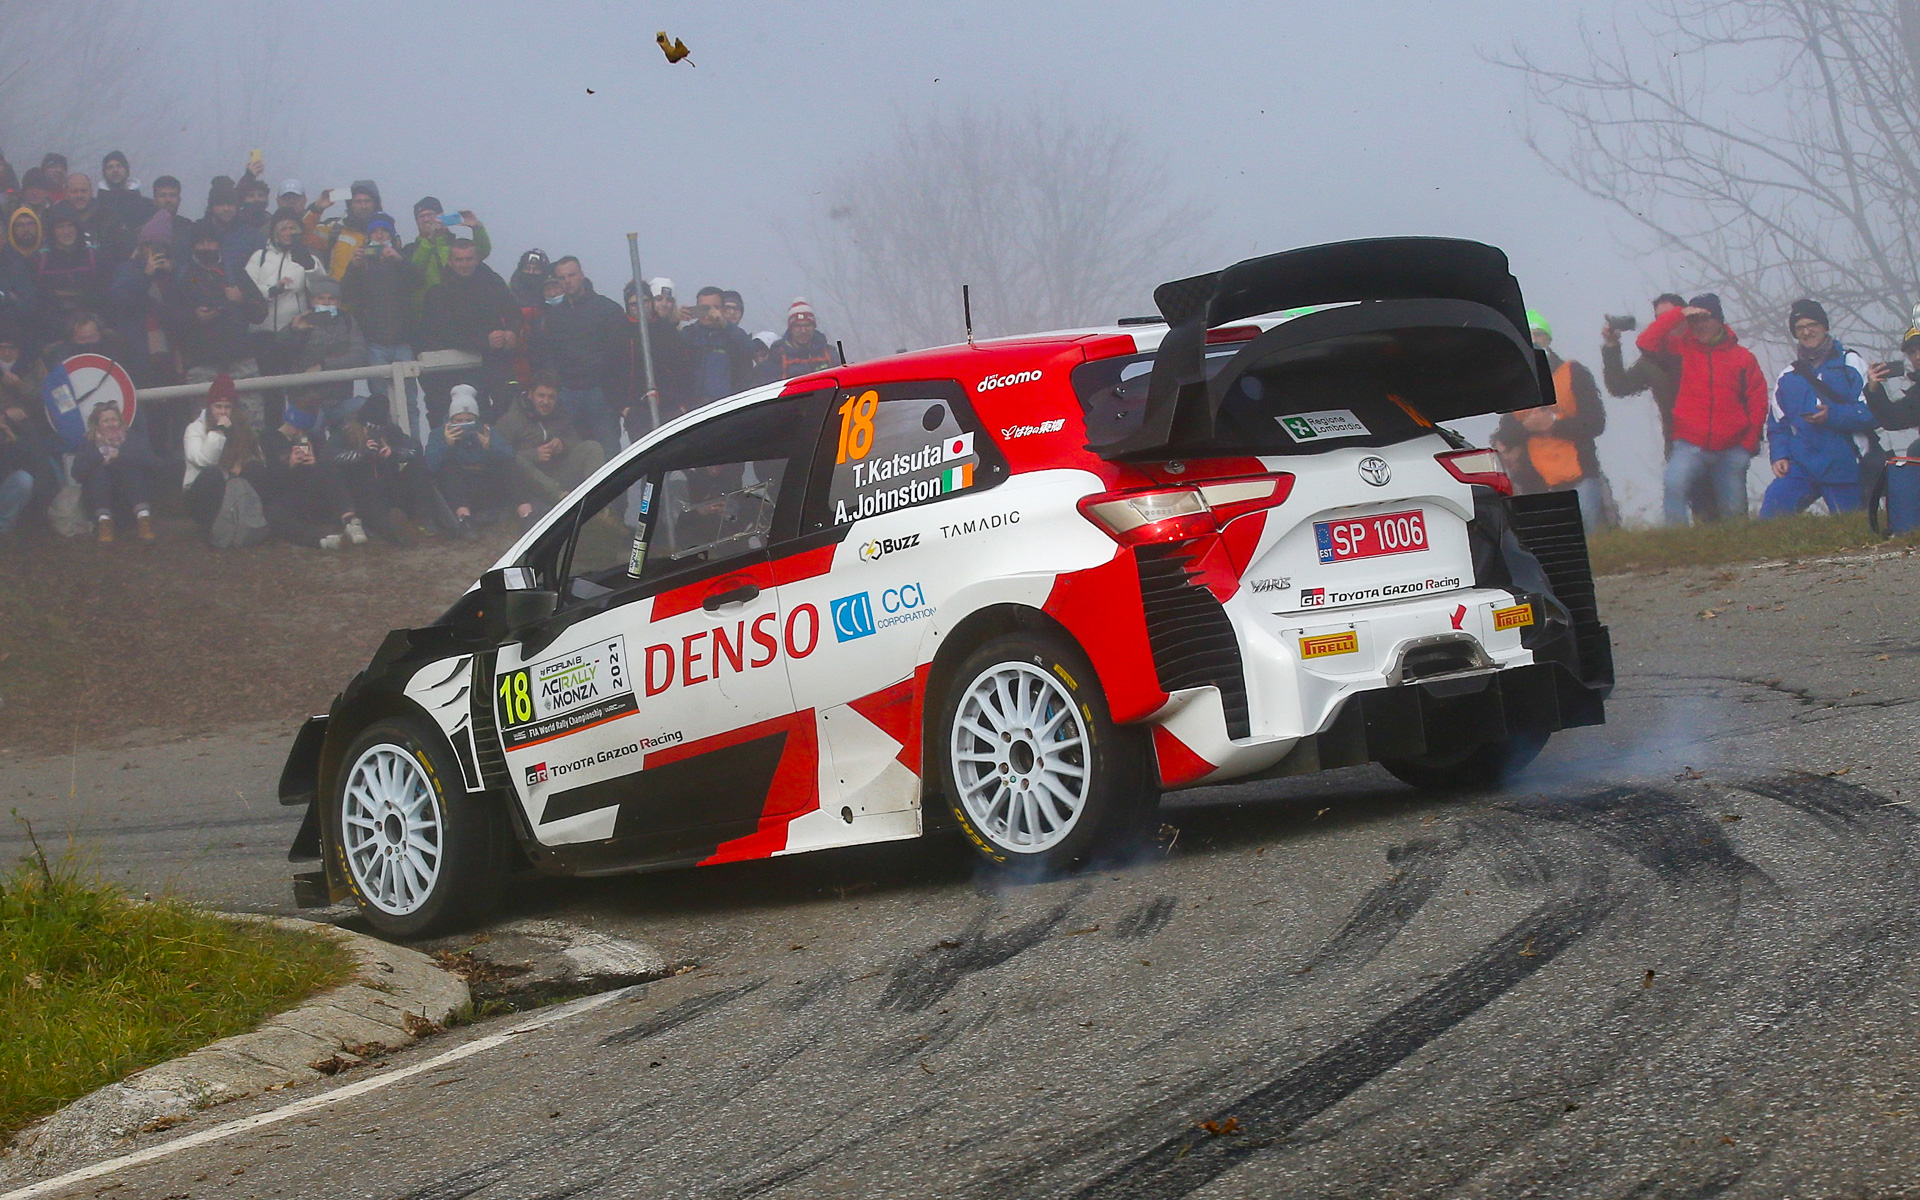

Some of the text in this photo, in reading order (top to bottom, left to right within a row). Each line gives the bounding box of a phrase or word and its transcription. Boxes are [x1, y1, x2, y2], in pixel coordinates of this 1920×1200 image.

[977, 370, 1043, 393] docomo
[836, 389, 879, 465] 18
[1307, 416, 1346, 426] Regione
[1313, 423, 1362, 434] Lombardia
[852, 444, 943, 488] T.Katsuta
[834, 475, 941, 526] A.Johnston
[940, 511, 1021, 539] TAMADIC
[1333, 515, 1424, 556] SP 1006
[1319, 548, 1333, 559] EST
[882, 582, 926, 614] CCI
[1301, 576, 1460, 606] GR TOYOTA GAZOO Racing
[877, 607, 937, 629] CORPORATION
[1497, 606, 1531, 628] PIRELLI
[644, 603, 820, 697] DENSO
[1304, 634, 1355, 656] PIRELLI
[608, 642, 623, 690] 2021
[500, 671, 532, 724] 18
[553, 682, 599, 710] MONZA
[529, 728, 540, 738] FIA
[539, 722, 556, 734] World
[556, 719, 569, 729] Rally
[568, 708, 603, 725] Championship
[527, 731, 683, 786] GR TOYOTA GAZOO Racing
